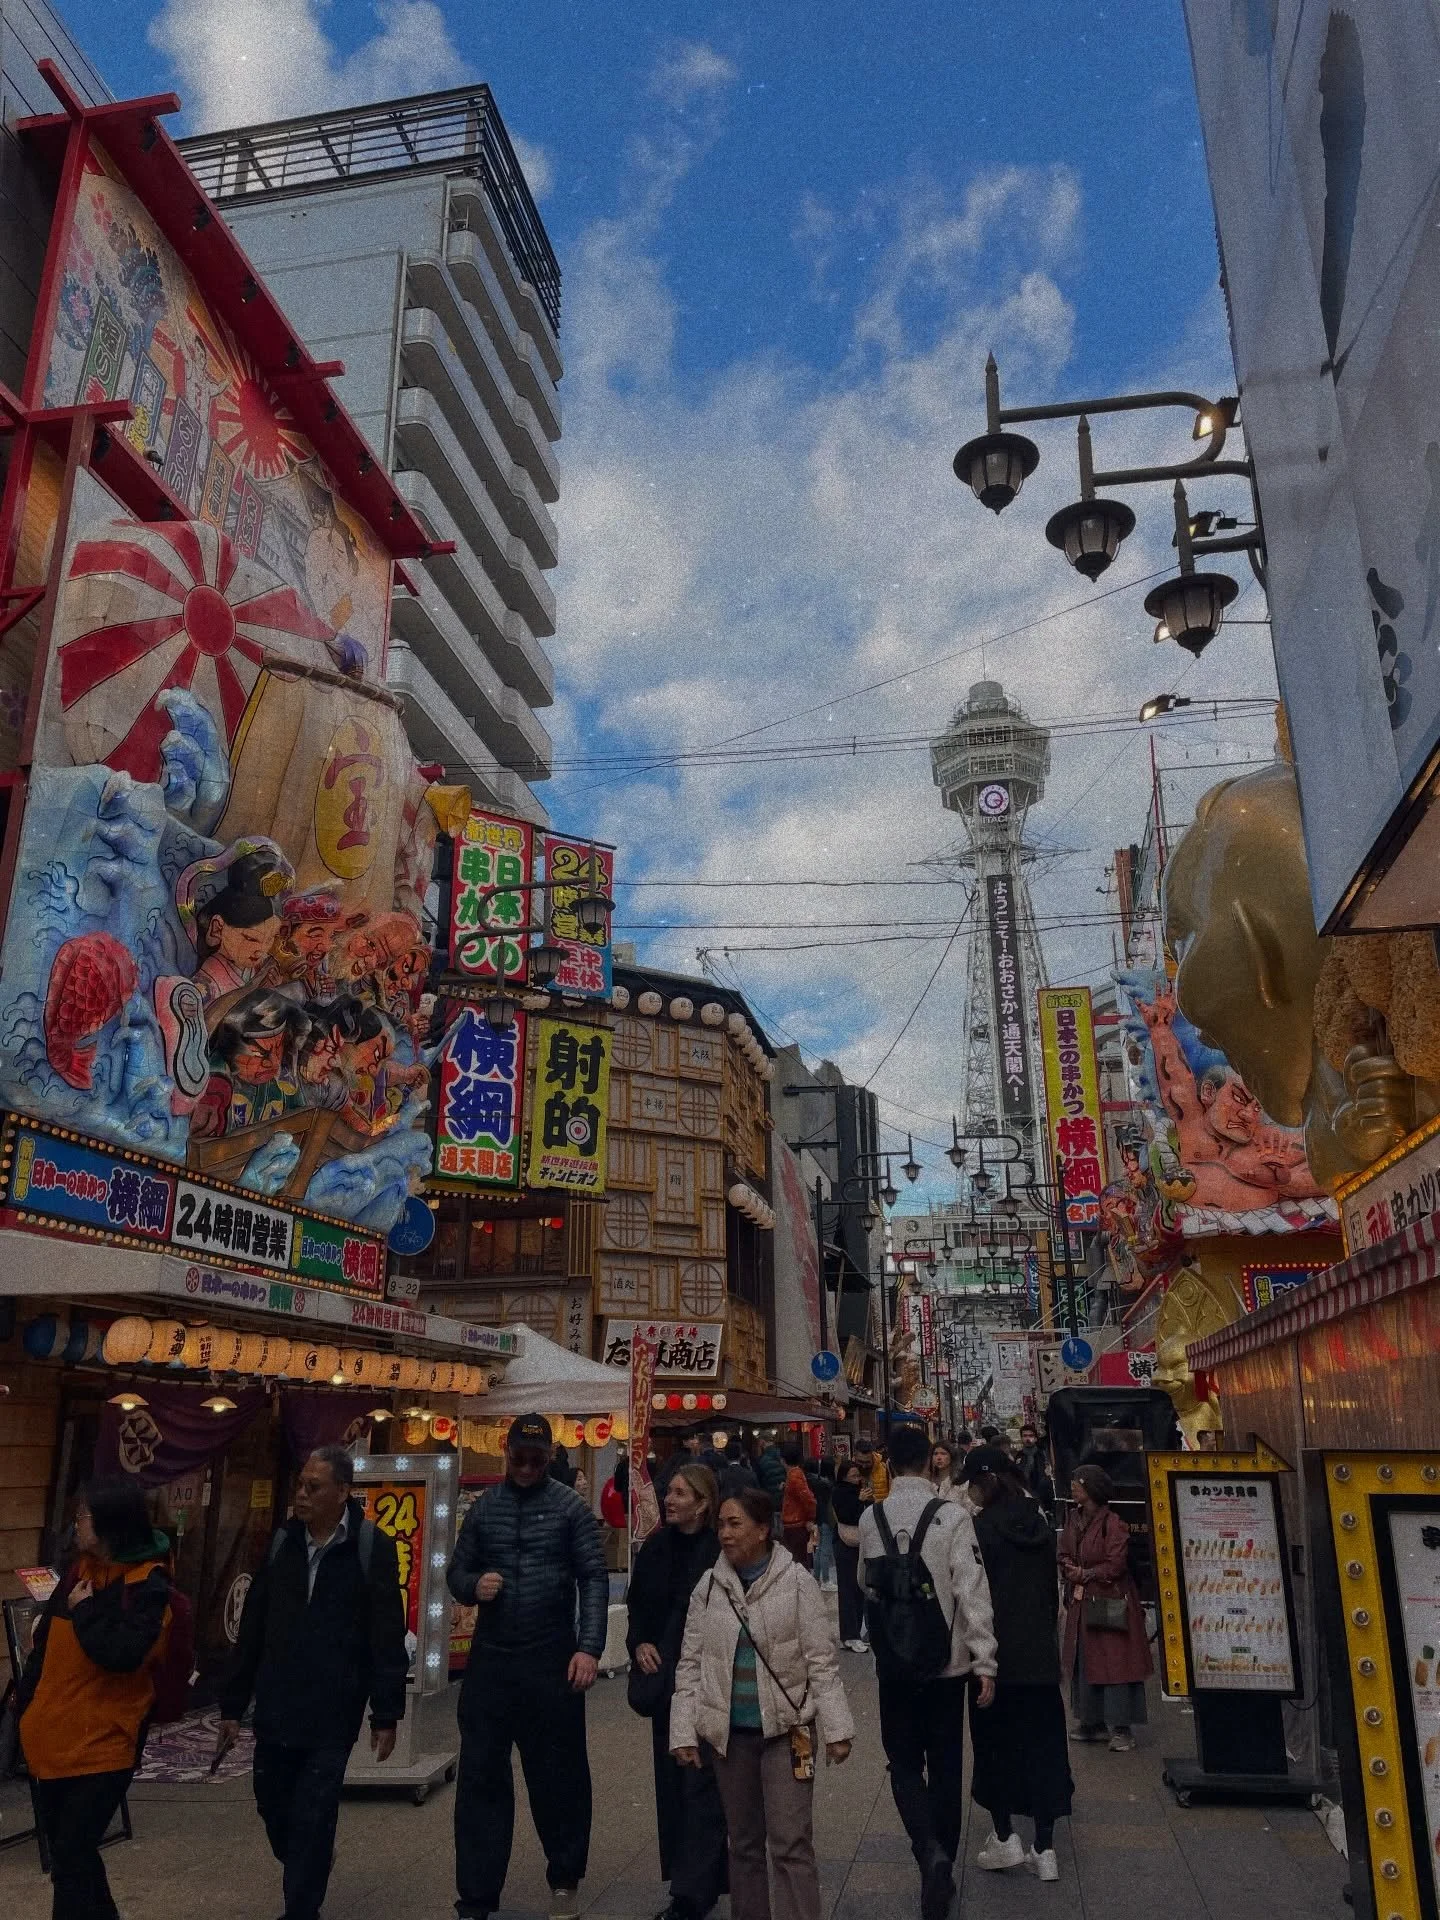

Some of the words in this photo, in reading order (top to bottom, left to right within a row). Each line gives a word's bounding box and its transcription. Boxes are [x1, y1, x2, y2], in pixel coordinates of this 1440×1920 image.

[465, 818, 523, 852] 新世界
[552, 847, 608, 888] 24
[491, 855, 521, 972] 日本の
[1046, 994, 1083, 1008] 新世界
[448, 1010, 518, 1146] 横綱
[691, 1047, 711, 1062] 大阪
[1056, 1010, 1085, 1115] 日本一の串かつ
[543, 1028, 606, 1157] 射的
[539, 1167, 599, 1187] チャンピオン
[1056, 1116, 1101, 1199] 横綱
[31, 1158, 108, 1203] 日本一の串かつ
[106, 1166, 170, 1234] 横綱
[176, 1193, 288, 1262] 24時間営業
[342, 1238, 380, 1286] 横綱
[375, 1492, 420, 1537] 24
